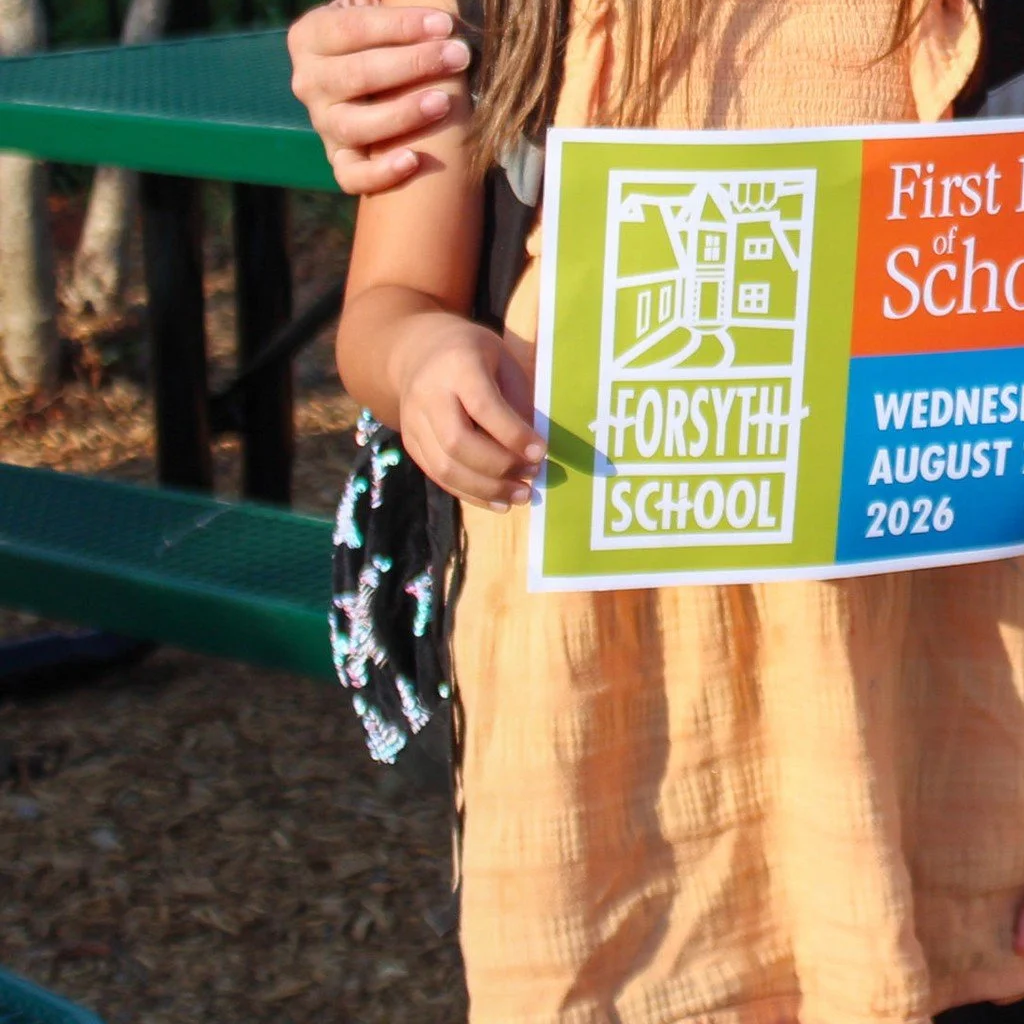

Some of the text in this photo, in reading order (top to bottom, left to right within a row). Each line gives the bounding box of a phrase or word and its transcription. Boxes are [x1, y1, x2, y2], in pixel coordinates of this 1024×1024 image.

[888, 161, 1002, 220] First
[933, 226, 958, 256] of
[589, 387, 810, 458] FORSYTH
[868, 441, 1012, 486] AUGUST
[611, 479, 777, 531] SCHOOL
[866, 496, 954, 538] 2026
